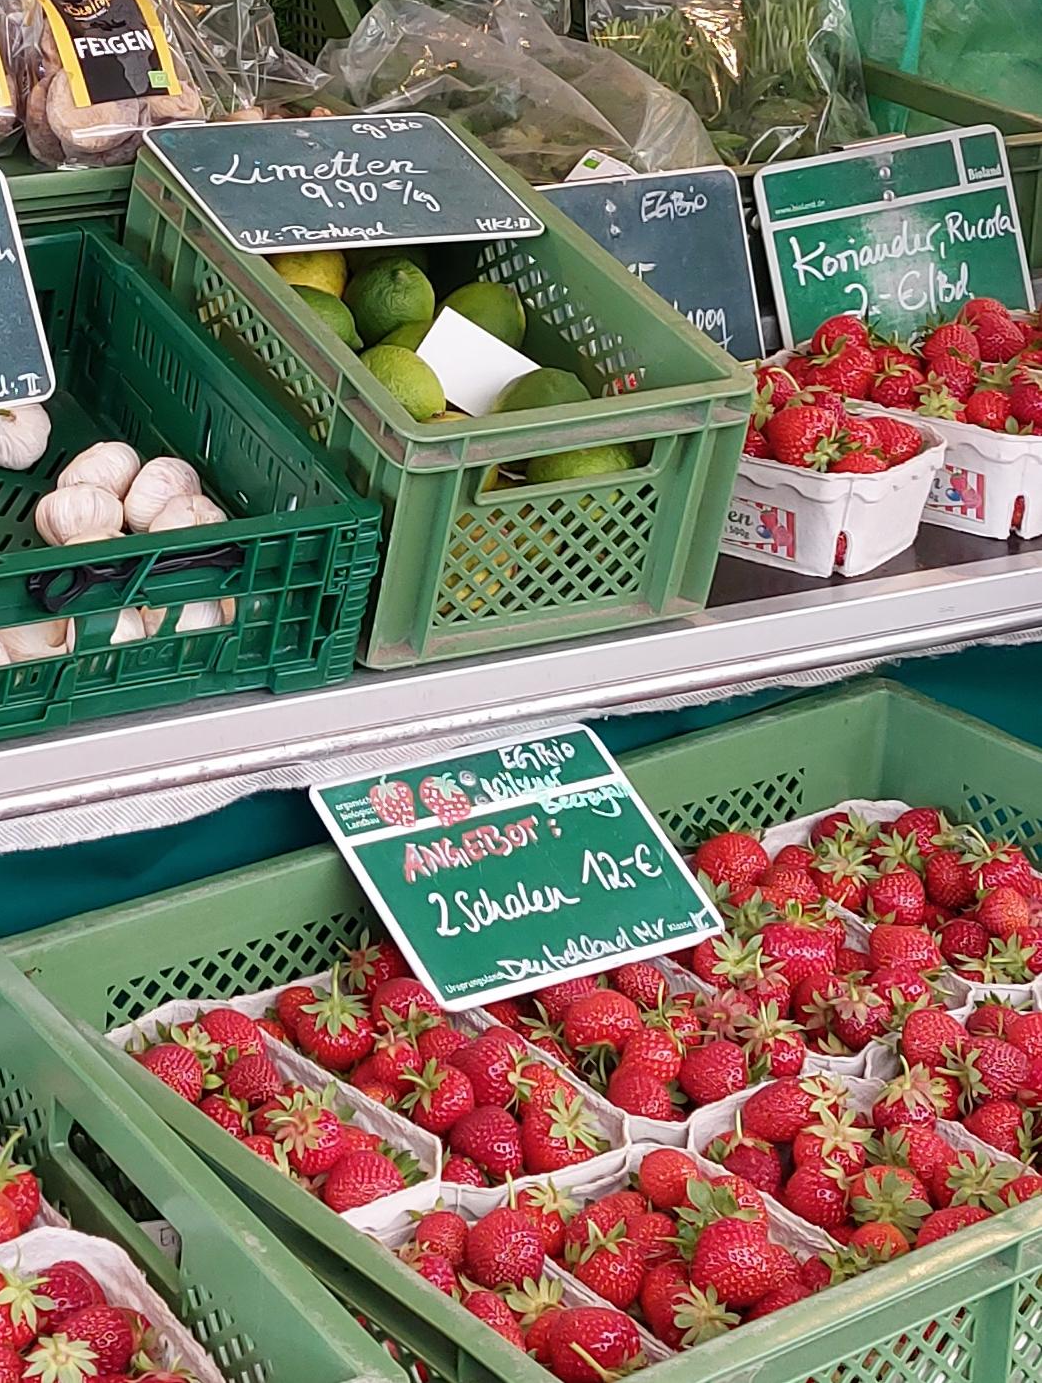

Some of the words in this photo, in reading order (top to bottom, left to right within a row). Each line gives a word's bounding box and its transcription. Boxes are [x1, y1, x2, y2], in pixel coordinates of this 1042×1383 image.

[73, 29, 155, 59] FEIGEN
[209, 150, 429, 186] Limetten
[967, 164, 1002, 181] Bioland
[281, 222, 397, 243] Portugal
[945, 204, 1017, 245] Rucola
[727, 510, 754, 526] en
[428, 892, 460, 937] 2
[454, 881, 581, 932] Schalen
